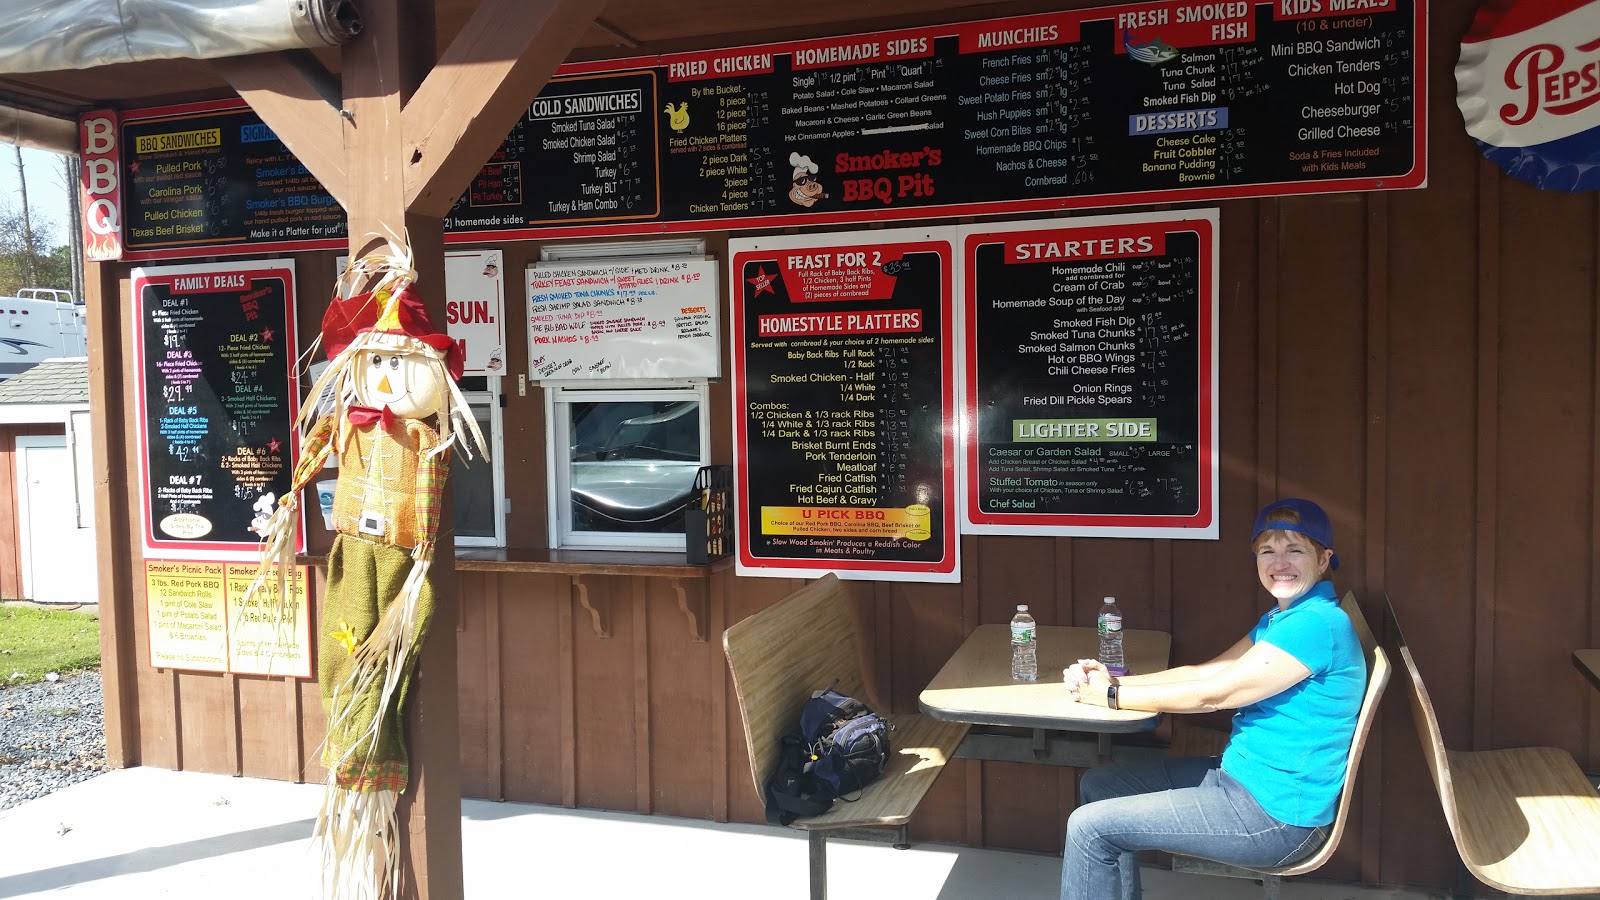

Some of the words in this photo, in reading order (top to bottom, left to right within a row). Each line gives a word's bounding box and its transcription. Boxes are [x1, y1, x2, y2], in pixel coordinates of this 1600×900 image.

[1118, 8, 1168, 30] FRESH
[1176, 1, 1248, 23] SMOKED
[1282, 0, 1322, 16] KIDS
[1212, 22, 1248, 40] FISH
[1296, 21, 1315, 34] (10
[1320, 20, 1328, 30] &
[1333, 16, 1372, 29] under)
[978, 24, 1059, 48] MUNCHIES
[795, 42, 880, 66] HOMEMADE
[886, 37, 928, 56] SIDES
[1271, 44, 1294, 56] Mini
[1297, 41, 1323, 54] BBQ
[1326, 36, 1380, 52] Sandwich
[1181, 52, 1215, 63] Salmon
[670, 60, 708, 78] FRIED
[713, 54, 772, 73] CHICKEN
[1500, 44, 1600, 125] PEPS
[532, 100, 561, 117] COLD
[565, 93, 638, 114] SANDWICHES
[958, 94, 982, 106] Sweet
[984, 92, 1010, 104] Potato
[1012, 90, 1032, 100] Fries
[1143, 96, 1178, 107] Smoked
[1180, 94, 1200, 104] Fish
[1201, 92, 1216, 104] Dip
[796, 118, 826, 127] Macaroni
[834, 115, 859, 124] Cheese
[866, 112, 884, 121] Garlic
[886, 111, 908, 120] Green
[908, 108, 932, 118] Beans
[1301, 103, 1380, 120] Cheeseburger
[551, 122, 578, 133] Smoked
[579, 120, 595, 131] Tuna
[596, 118, 615, 129] Salad
[1136, 110, 1217, 132] DESSERTS
[669, 137, 687, 147] Fried
[689, 135, 718, 146] Chicken
[720, 133, 747, 143] Platters
[1298, 127, 1337, 141] Grilled
[1338, 125, 1380, 138] Cheese
[140, 138, 158, 152] BBQ
[161, 131, 217, 148] SANDWICHES
[976, 143, 1020, 156] Homemade
[1022, 142, 1042, 153] BBQ
[1044, 140, 1067, 152] Chips
[835, 146, 942, 174] Smoker's
[1154, 150, 1176, 160] Fruit
[1178, 147, 1216, 158] Cobbler
[1289, 151, 1310, 161] Soda
[1313, 151, 1319, 159] &
[1321, 150, 1342, 159] Fries
[1344, 147, 1379, 157] Included
[156, 163, 181, 173] Pulled
[183, 161, 201, 170] Pork
[595, 166, 616, 179] Turkey
[1142, 162, 1176, 172] Banana
[1178, 159, 1216, 172] Pudding
[1024, 174, 1067, 186] Cornbread
[1179, 172, 1215, 182] Brownie
[842, 178, 892, 204] BBQ
[898, 173, 934, 198] Pit
[690, 204, 718, 213] Chicken
[720, 202, 748, 211] Tenders
[455, 217, 500, 226] homemade
[503, 215, 523, 224] sides
[131, 227, 154, 238] Texas
[156, 226, 174, 235] Beef
[176, 223, 203, 234] Brisket
[250, 228, 270, 238] Make
[272, 229, 277, 237] it
[286, 227, 310, 236] Platter
[312, 225, 322, 234] for
[324, 225, 338, 235] just
[1016, 236, 1154, 260] STARTERS
[788, 254, 832, 270] FEAST
[837, 252, 868, 268] FOR
[872, 251, 882, 267] 2
[1052, 265, 1102, 275] Homemade
[1105, 263, 1125, 272] Chili
[174, 276, 211, 290] FAMILY
[214, 275, 245, 287] DEALS
[531, 278, 554, 289] TURKEY
[555, 278, 574, 287] FEAST
[576, 278, 609, 286] SANDWICH
[814, 291, 831, 299] pieces
[447, 301, 494, 324] SUN.
[760, 316, 843, 333] HOMESTYLE
[849, 312, 920, 330] PLATTERS
[1030, 331, 1069, 341] Smoked
[1072, 330, 1095, 339] Tuna
[1098, 328, 1135, 338] Chunks
[1073, 384, 1101, 393] Onion
[1105, 384, 1132, 394] Rings
[169, 407, 186, 415] DEAL
[1018, 423, 1100, 438] LIGHTER
[1106, 422, 1151, 437] SIDE
[989, 448, 1022, 456] Caesar
[1036, 448, 1072, 456] Garden
[1074, 447, 1101, 456] Salad
[837, 463, 877, 472] Meatloaf
[990, 478, 1022, 486] Stuffed
[1024, 478, 1058, 486] Tomato
[798, 495, 814, 504] Hot
[816, 495, 838, 504] Beef
[839, 496, 847, 504] &
[850, 496, 877, 506] Gravy
[990, 500, 1010, 508] Chef
[1012, 500, 1035, 508] Salad
[802, 510, 812, 518] U
[818, 510, 850, 519] PICK
[855, 510, 885, 520] BBQ
[810, 539, 835, 547] Smokin'
[874, 540, 900, 548] Reddish
[902, 541, 921, 549] Color
[148, 564, 180, 573] Smoker's
[182, 565, 202, 574] Picnic
[205, 566, 222, 574] Pack
[203, 581, 220, 589] BBQ
